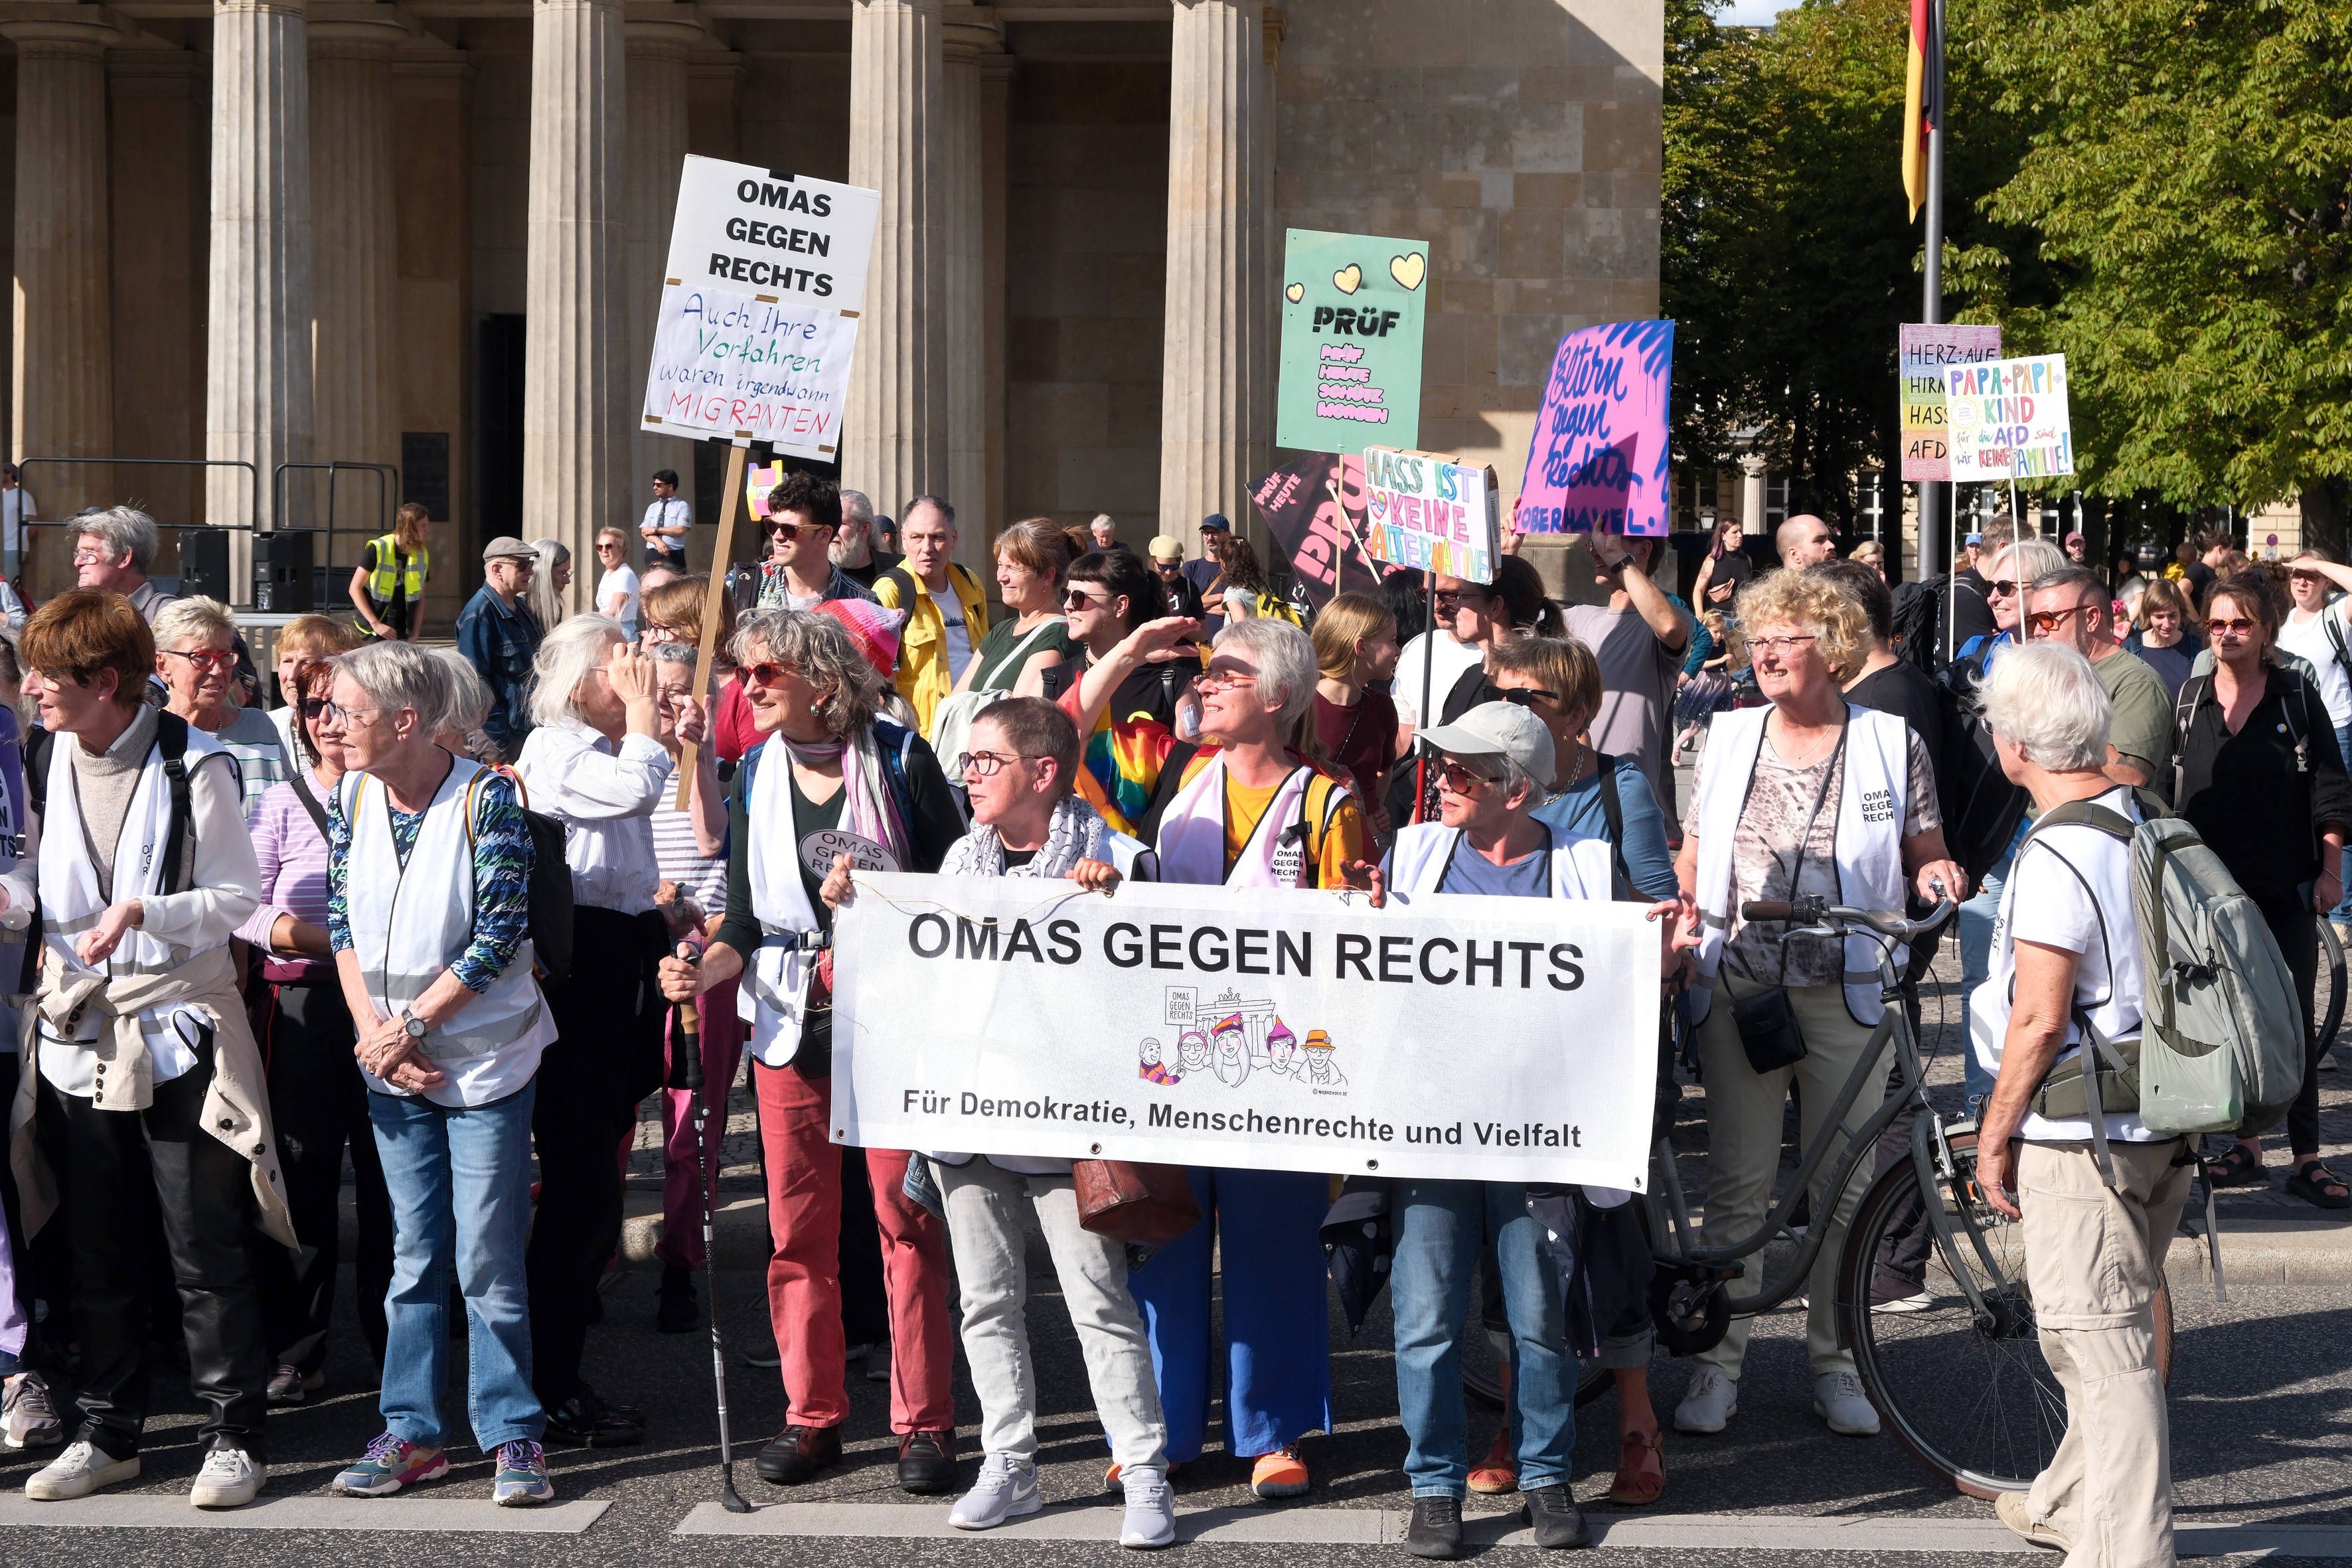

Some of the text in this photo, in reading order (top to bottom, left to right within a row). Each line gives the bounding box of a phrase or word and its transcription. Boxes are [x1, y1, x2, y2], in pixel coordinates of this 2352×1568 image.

[737, 179, 832, 217] OMAS
[726, 217, 830, 258] GEGEN
[708, 253, 833, 297] RECHTS
[682, 293, 817, 340] Auch Ihre
[1312, 306, 1401, 337] PRÜF
[698, 329, 821, 373] Vorfahren
[1320, 343, 1365, 364] PRÜF
[659, 365, 830, 403] waren irgendwann
[1318, 364, 1371, 383] HEUTE
[1318, 382, 1384, 404] SCHÜTZ
[666, 389, 831, 435] MIGRANTEN
[1316, 400, 1389, 424] MORGEN
[1984, 396, 2035, 424] KIND
[1909, 439, 1947, 459] AFD
[1994, 426, 2029, 449] AfD
[2034, 426, 2057, 439] sind
[1366, 449, 1478, 503] HASS IST
[1542, 442, 1644, 492] Rechts
[1255, 472, 1282, 505] PRÜF
[1388, 491, 1469, 543] KEINE
[1372, 522, 1488, 582] ALTERNATIVE
[821, 833, 882, 858] OMAS
[1274, 860, 1303, 868] GEGEN
[908, 912, 1585, 991] OMAS GEGEN RECHTS
[1170, 1001, 1190, 1010] GEGEN
[1172, 992, 1189, 1000] OMAS
[1170, 1010, 1193, 1020] RECHTS
[903, 1089, 1581, 1149] Für Demokratie, Menschenrechte und Vielfalt
